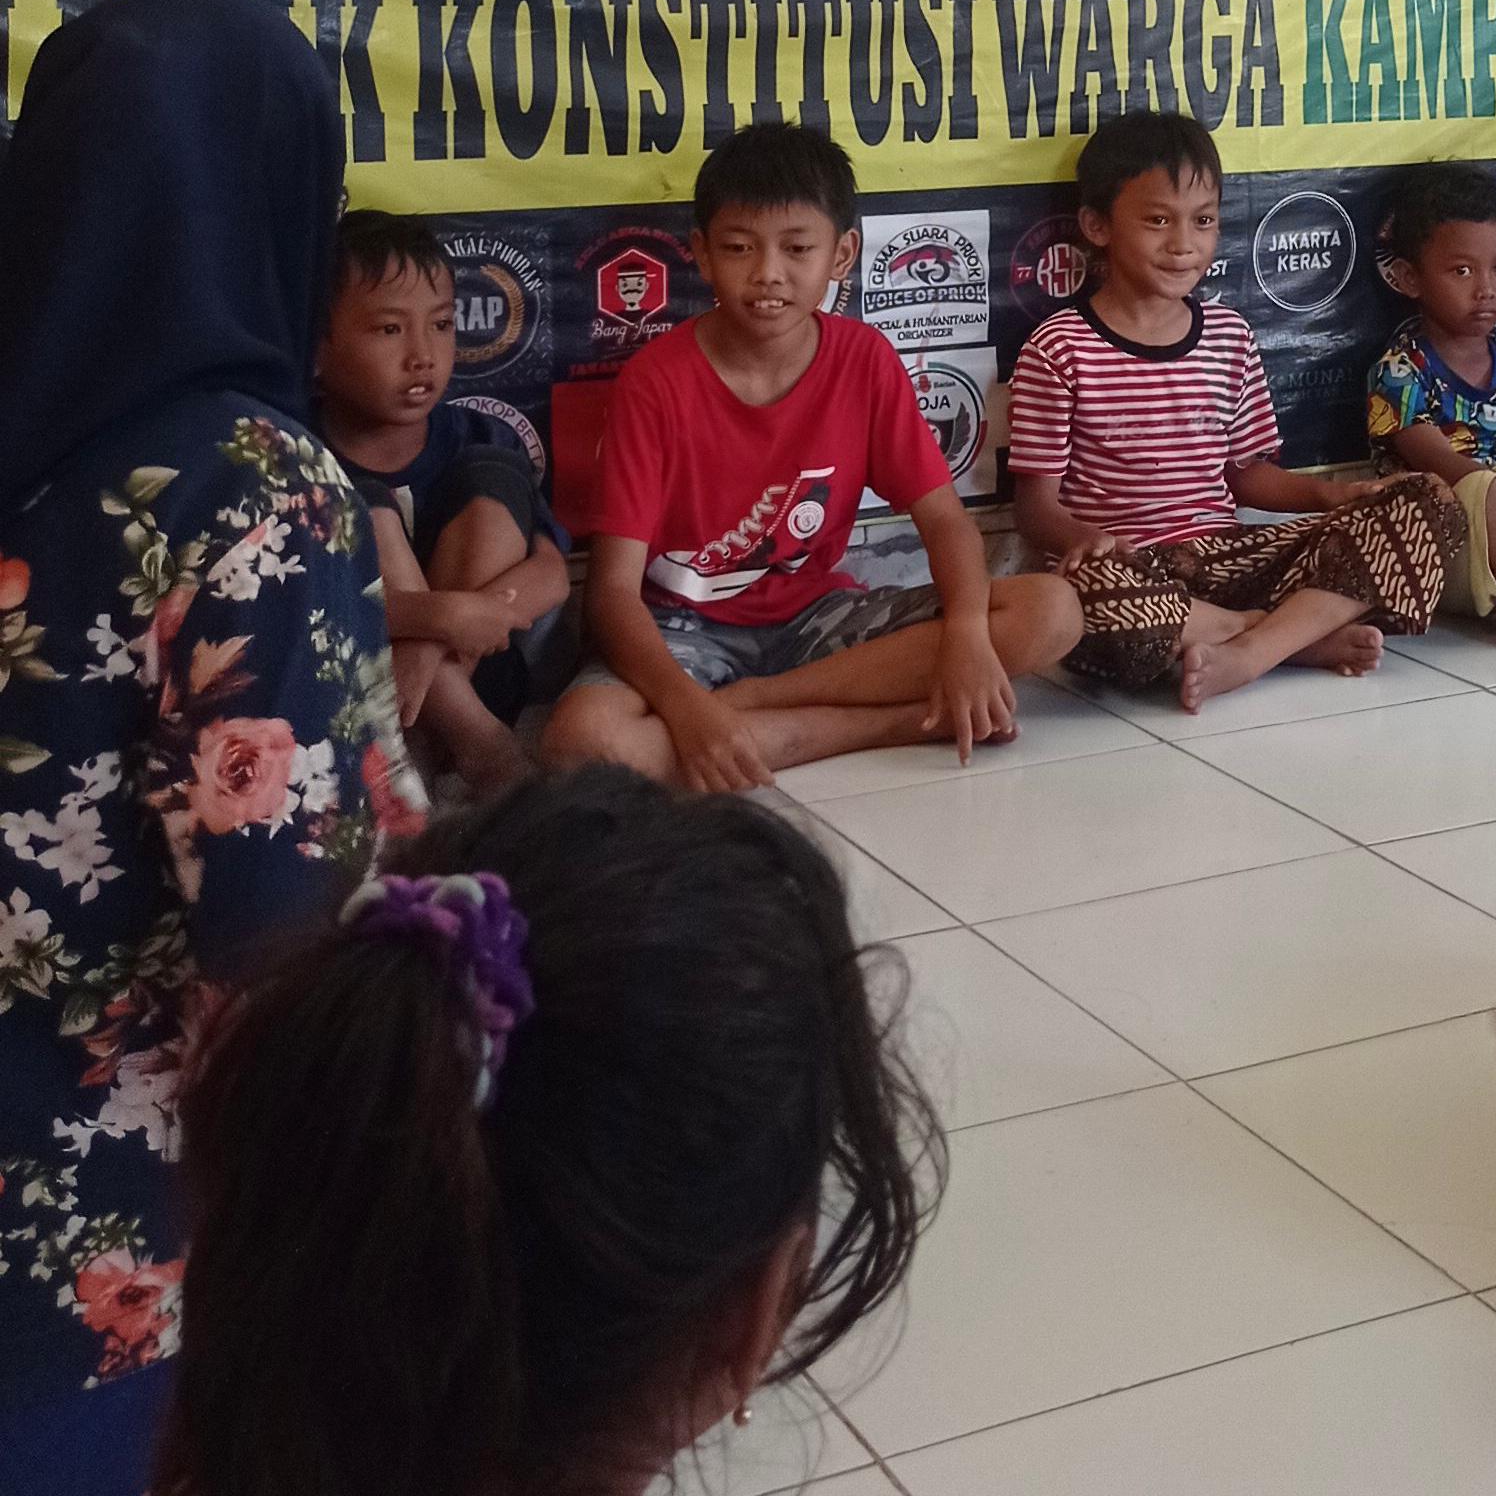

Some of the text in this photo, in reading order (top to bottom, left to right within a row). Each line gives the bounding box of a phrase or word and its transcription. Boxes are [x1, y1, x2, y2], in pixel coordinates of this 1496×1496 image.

[1269, 230, 1342, 252] JAKARTA
[872, 227, 981, 285] GEMA SUARA PRIOK
[1277, 252, 1333, 273] KERAS
[865, 284, 987, 311] VOICE OF PRIOK
[591, 318, 628, 345] Bang
[912, 313, 987, 329] HUMANITARIAN
[897, 328, 954, 342] ORGANIZER
[916, 395, 951, 412] OJA
